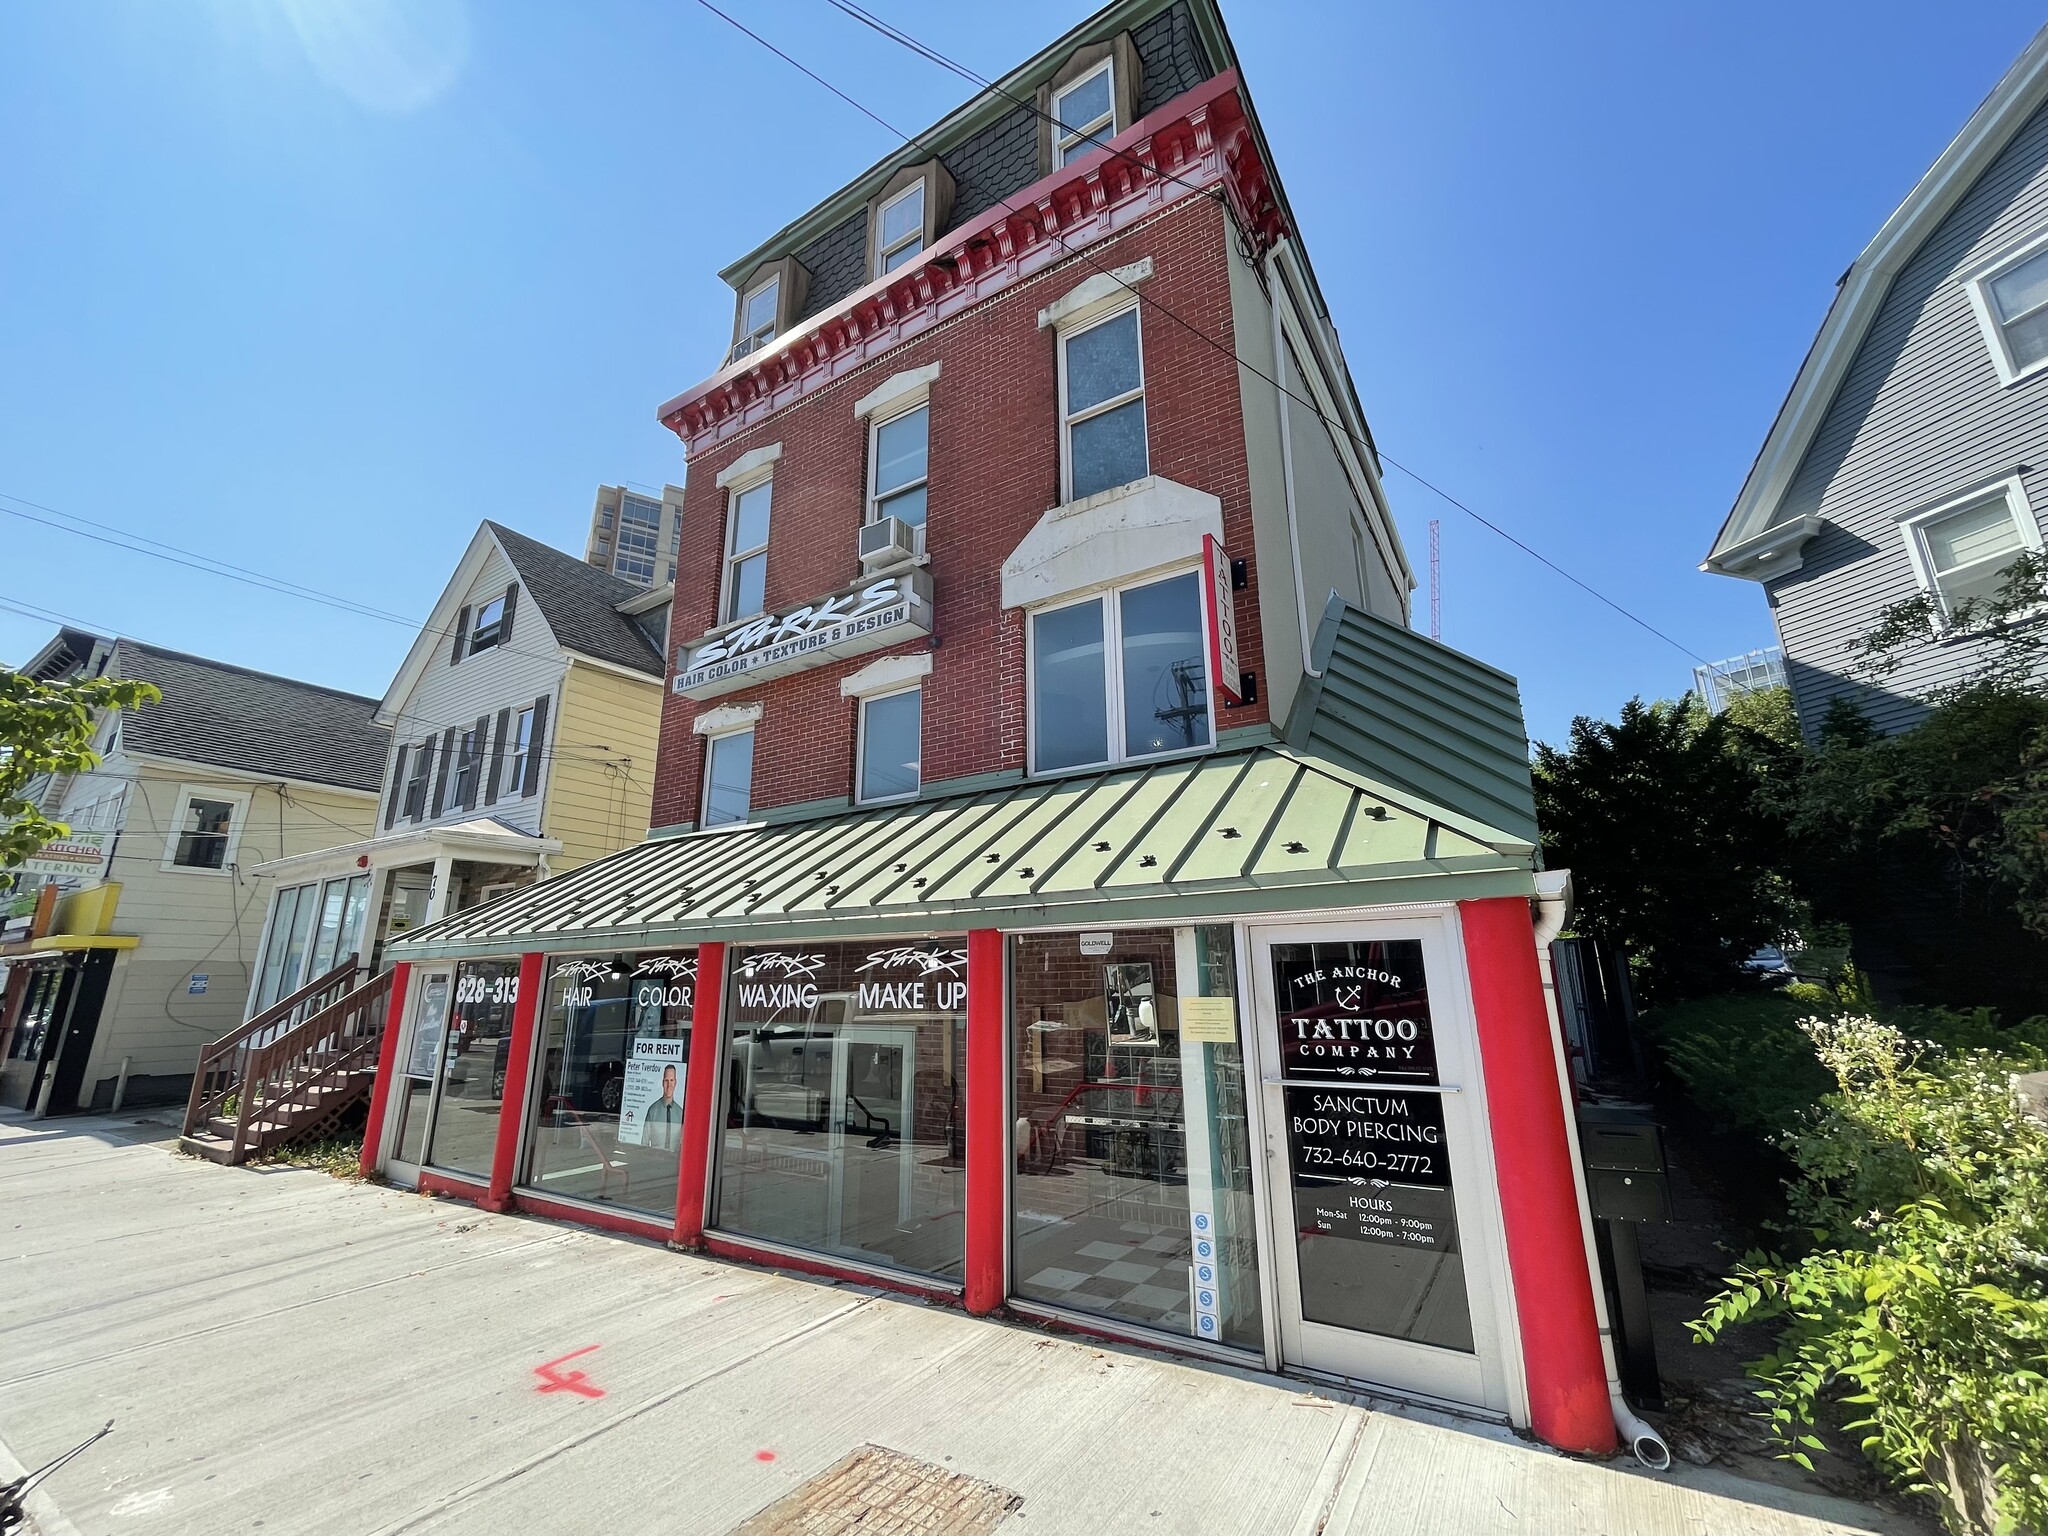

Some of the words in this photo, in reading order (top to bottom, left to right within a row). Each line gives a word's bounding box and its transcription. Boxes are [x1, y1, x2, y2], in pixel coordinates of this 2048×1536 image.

[1217, 548, 1232, 654] TATTOO
[687, 578, 898, 671] STARKS
[677, 672, 704, 689] HAIR
[709, 658, 748, 680] COLOR
[763, 632, 827, 662] TEXTURE
[832, 628, 841, 641] &
[846, 607, 904, 637] DESIGN
[47, 843, 102, 855] KITCHEN
[1294, 970, 1327, 988] THE
[1332, 966, 1402, 989] ANCHOR
[562, 986, 592, 1007] HAIR
[638, 986, 692, 1007] COLOR
[738, 983, 818, 1009] WAXING
[858, 982, 924, 1009] MAKE
[937, 982, 967, 1010] UP
[1291, 1018, 1418, 1040] TATTOO
[636, 1043, 653, 1055] FOR
[656, 1044, 680, 1056] RENT
[1300, 1044, 1415, 1059] COMPANY
[627, 1061, 640, 1071] Peter
[1314, 1095, 1408, 1116] SANCTUM
[1294, 1116, 1341, 1136] BODY
[1347, 1120, 1437, 1143] PIERCING
[1303, 1146, 1433, 1173] 732-640-2772
[1349, 1196, 1393, 1211] HOURS
[1316, 1207, 1348, 1219] Mon-Sat
[1359, 1213, 1392, 1226] 12:00pm
[1401, 1218, 1433, 1230] 9:00pm
[1317, 1220, 1332, 1230] Sun
[1360, 1226, 1394, 1238] 12:00pm
[1402, 1231, 1435, 1244] 7:00pm
